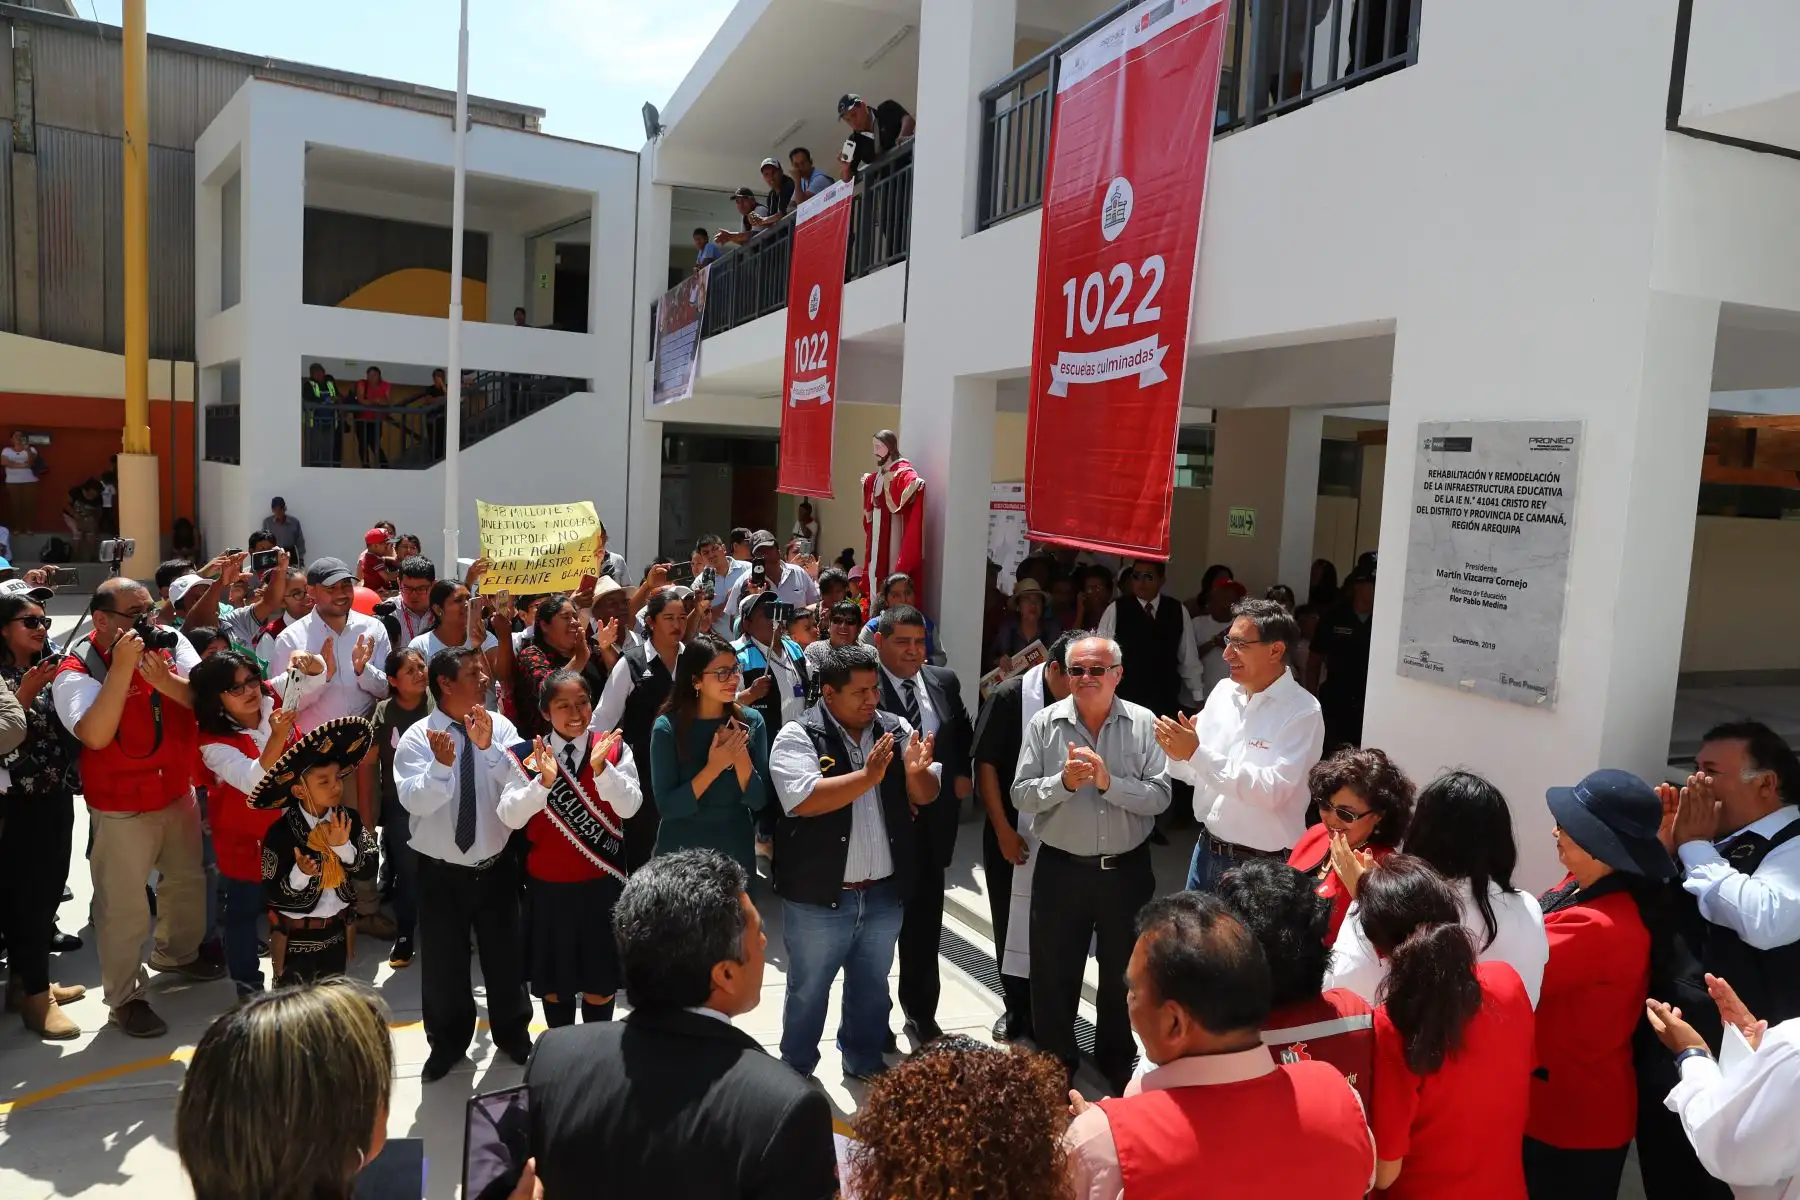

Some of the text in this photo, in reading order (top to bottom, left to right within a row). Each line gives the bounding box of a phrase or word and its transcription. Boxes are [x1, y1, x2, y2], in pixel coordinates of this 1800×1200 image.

[1063, 254, 1166, 339] 1022
[795, 330, 828, 374] 1022
[1060, 348, 1154, 376] escuelas culminadas
[1428, 469, 1561, 483] REHABILITACIÓN Y REMODELACIÓN
[1423, 481, 1563, 497] DE LA INFRAESTRUCTURA EDUCATIVA
[1434, 494, 1444, 503] DE
[1445, 495, 1454, 504] LA
[1455, 495, 1463, 504] IE
[1476, 497, 1499, 507] 41041
[1501, 498, 1530, 508] CRISTO
[1530, 500, 1547, 509] REY
[552, 516, 596, 529] NICOLAS
[1416, 505, 1567, 526] DEL DISTRITO Y PROVINCIA DE CAMANÁ,
[1451, 520, 1521, 535] REGIÓN AREQUIPA
[482, 530, 579, 546] DE PIEROLA NO
[486, 547, 525, 559] TIENE
[530, 542, 566, 557] AGUA
[486, 560, 518, 571] PLAN
[524, 556, 574, 571] MAESTRO
[1465, 562, 1498, 573] Presidente
[483, 571, 552, 585] ELEFANTE
[1436, 569, 1528, 589] Martín Vizcarra Cornejo
[1451, 586, 1473, 596] Ministra
[1480, 590, 1507, 601] Educación
[1449, 594, 1508, 610] Flor Pablo Medina
[1481, 641, 1496, 650] 2019
[602, 836, 620, 855] 2019
